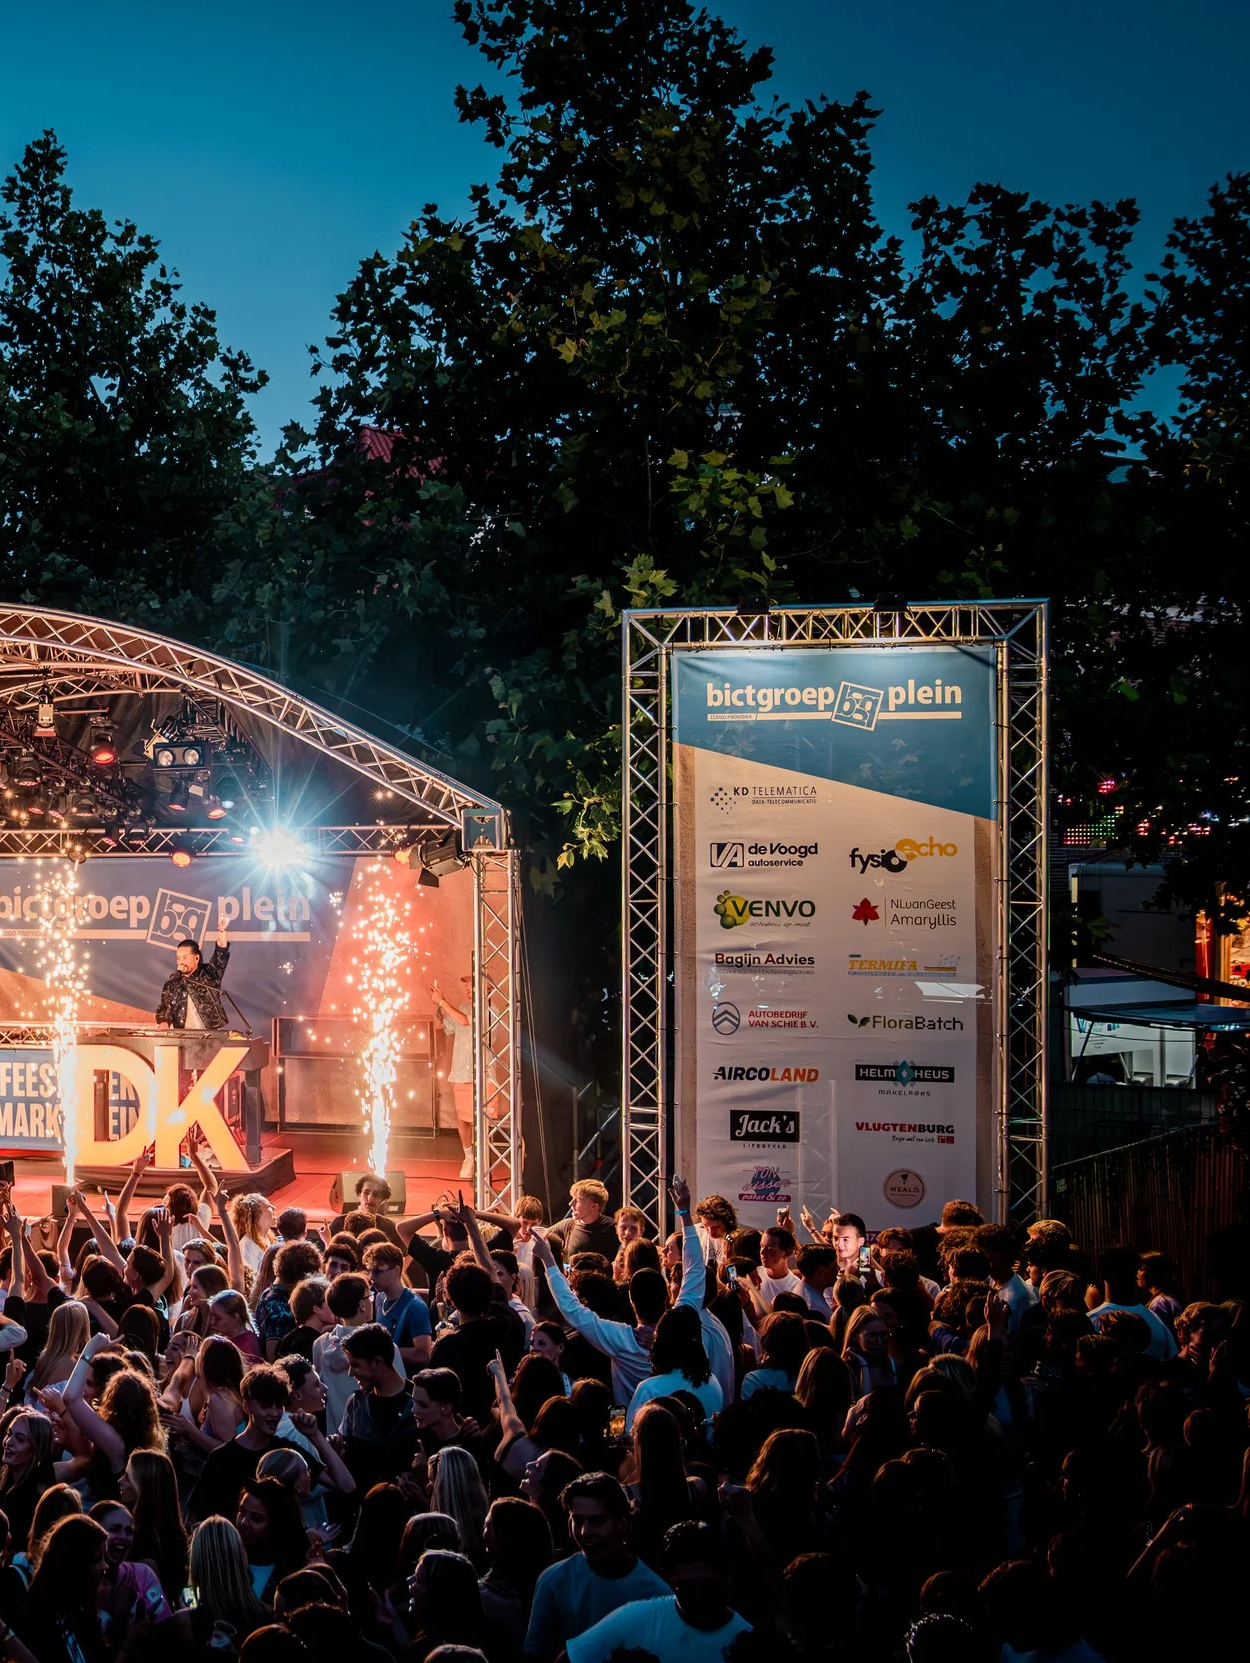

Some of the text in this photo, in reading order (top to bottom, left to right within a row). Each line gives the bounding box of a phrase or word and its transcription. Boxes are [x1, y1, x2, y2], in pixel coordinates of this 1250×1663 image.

[706, 682, 834, 713] bictgroep
[888, 679, 962, 711] plein
[733, 786, 817, 796] KD TELEMATICA
[748, 859, 804, 867] autoservice
[217, 886, 311, 926] plein
[731, 900, 816, 917] VENVO
[890, 914, 957, 930] Amaryllis
[715, 953, 815, 968] Bagijn Advies
[748, 1010, 808, 1019] AUTOBEDRIJF
[748, 1020, 819, 1029] VAN SCHIE B.V.
[872, 1015, 964, 1031] FloraBatch
[713, 1066, 819, 1083] AIRCOLAND
[859, 1067, 950, 1080] HELM HEUS
[878, 1089, 931, 1097] MAKELAARS
[75, 1044, 251, 1171] DK
[735, 1113, 796, 1138] Jack's
[855, 1121, 955, 1134] VLUGTENBURG
[754, 1165, 781, 1179] TON
